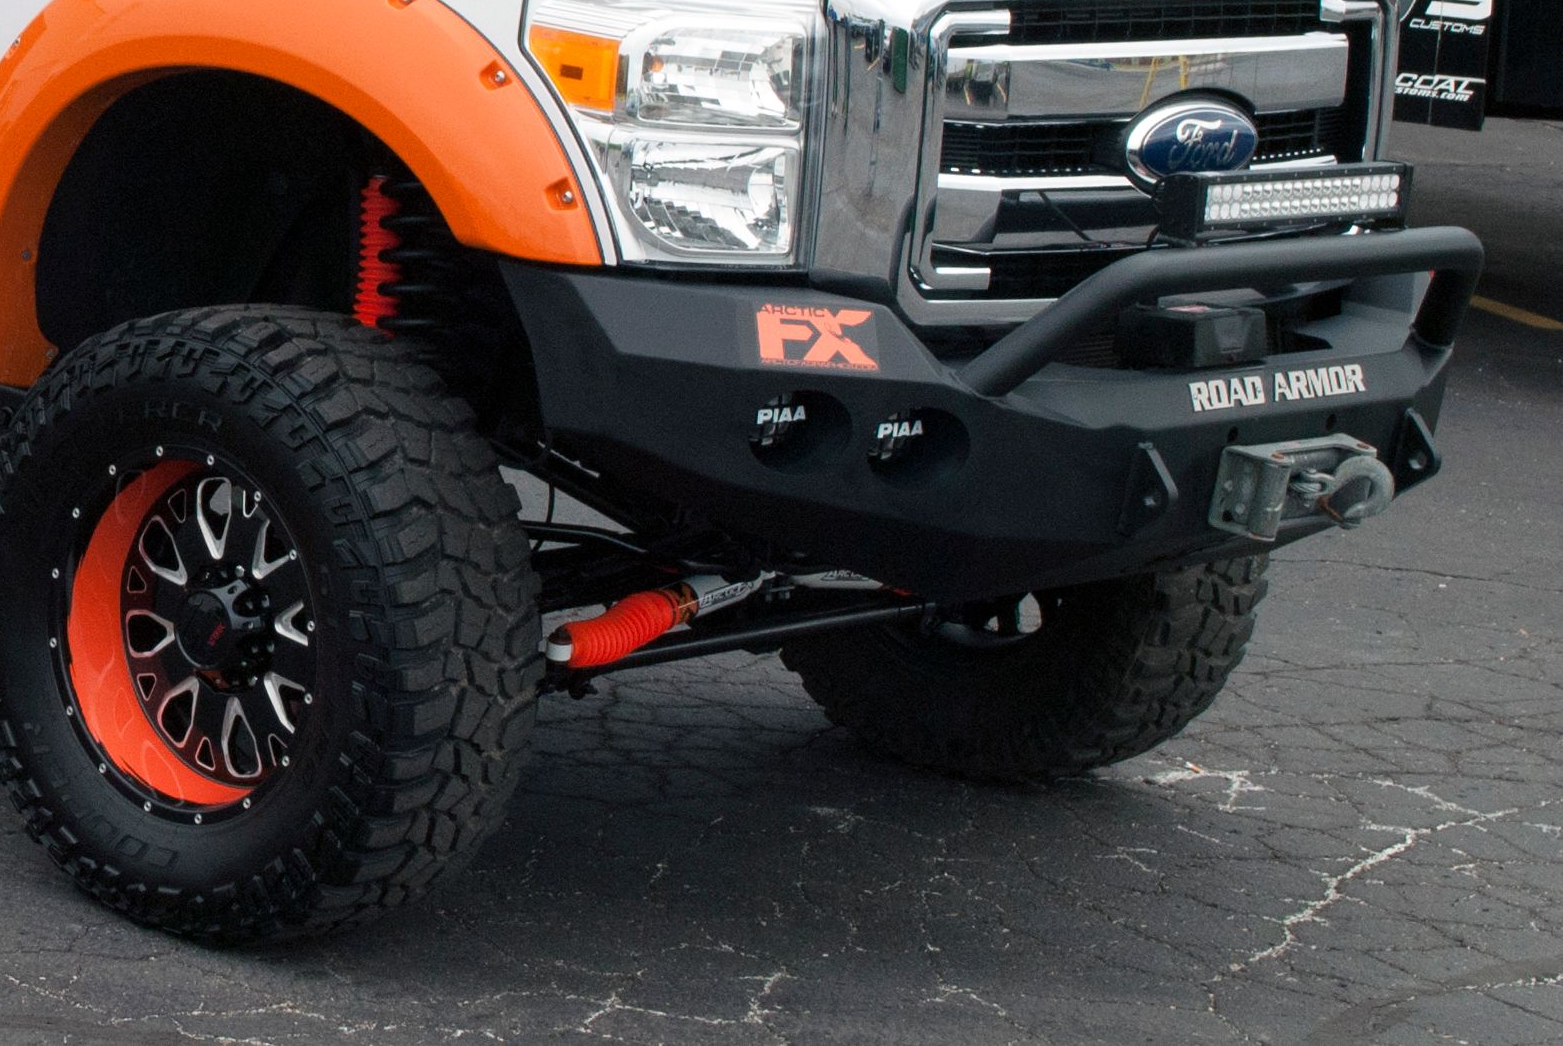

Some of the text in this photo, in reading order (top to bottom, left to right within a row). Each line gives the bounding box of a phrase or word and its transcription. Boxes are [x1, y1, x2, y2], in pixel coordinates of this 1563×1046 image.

[1409, 18, 1486, 35] CUSTOMS
[1168, 118, 1239, 170] Ford
[759, 305, 825, 318] ARCTIC
[1189, 364, 1366, 413] ROAD ARMOR
[756, 405, 807, 425] PIAA
[876, 420, 924, 439] PIAA
